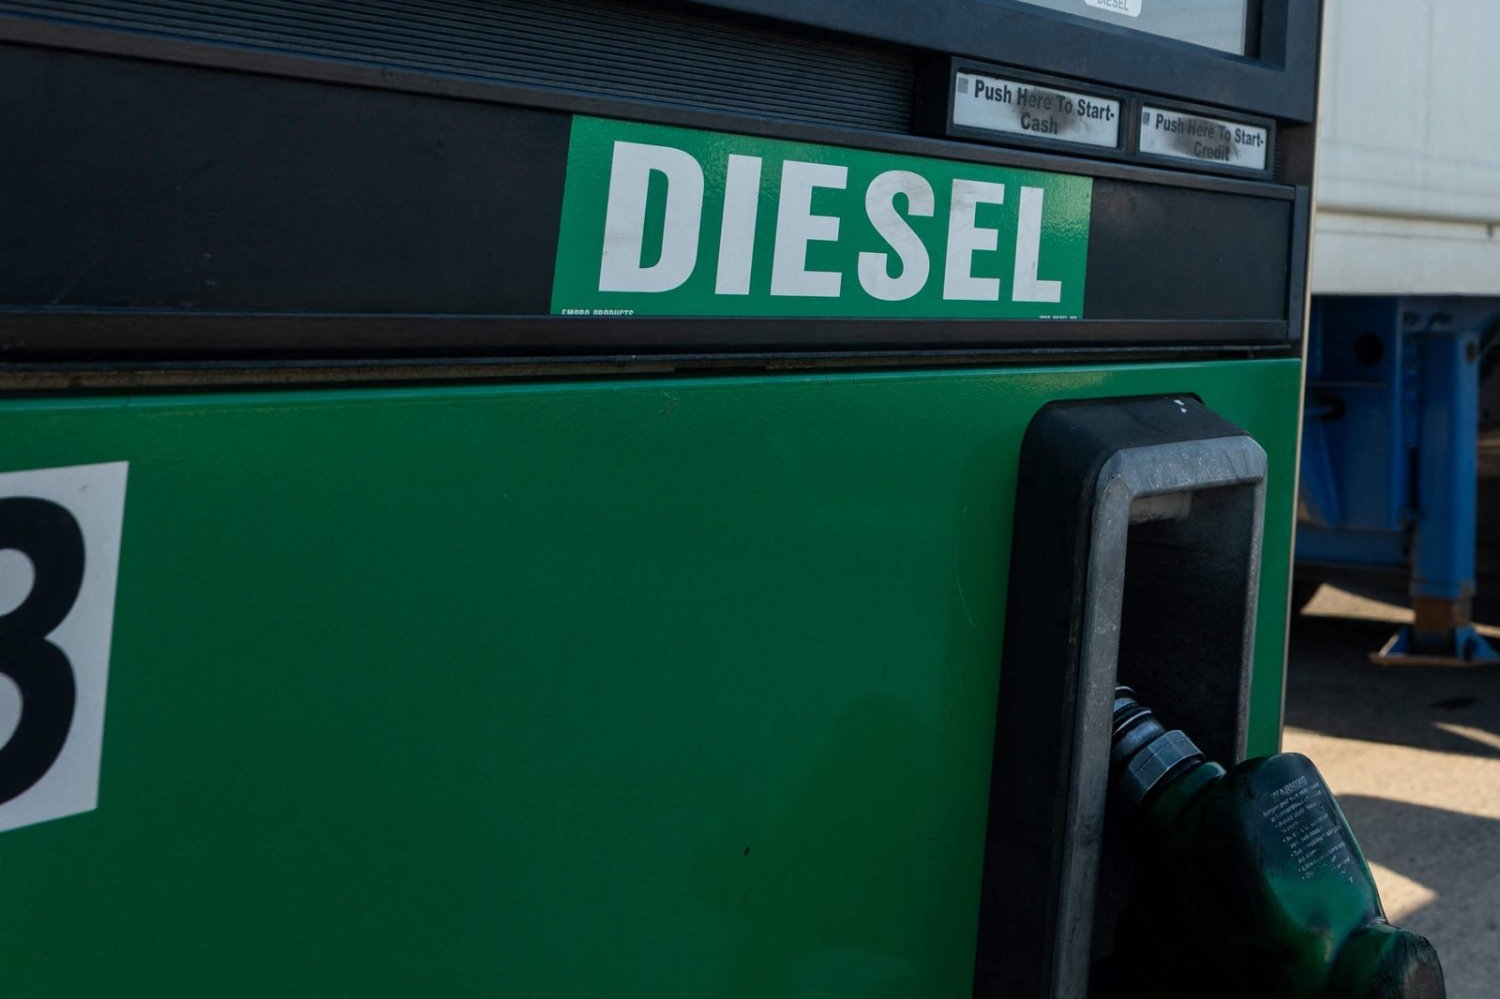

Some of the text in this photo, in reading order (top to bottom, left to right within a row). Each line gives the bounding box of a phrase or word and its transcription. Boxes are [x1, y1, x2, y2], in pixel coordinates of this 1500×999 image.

[974, 79, 1012, 104] Push
[1016, 88, 1051, 110] Here
[1055, 94, 1073, 114] To
[1020, 111, 1058, 135] Cash
[1155, 113, 1184, 134] Push
[1187, 118, 1215, 139] Here
[1218, 124, 1232, 142] To
[1194, 141, 1230, 162] Credit
[598, 140, 1062, 303] DIESEL
